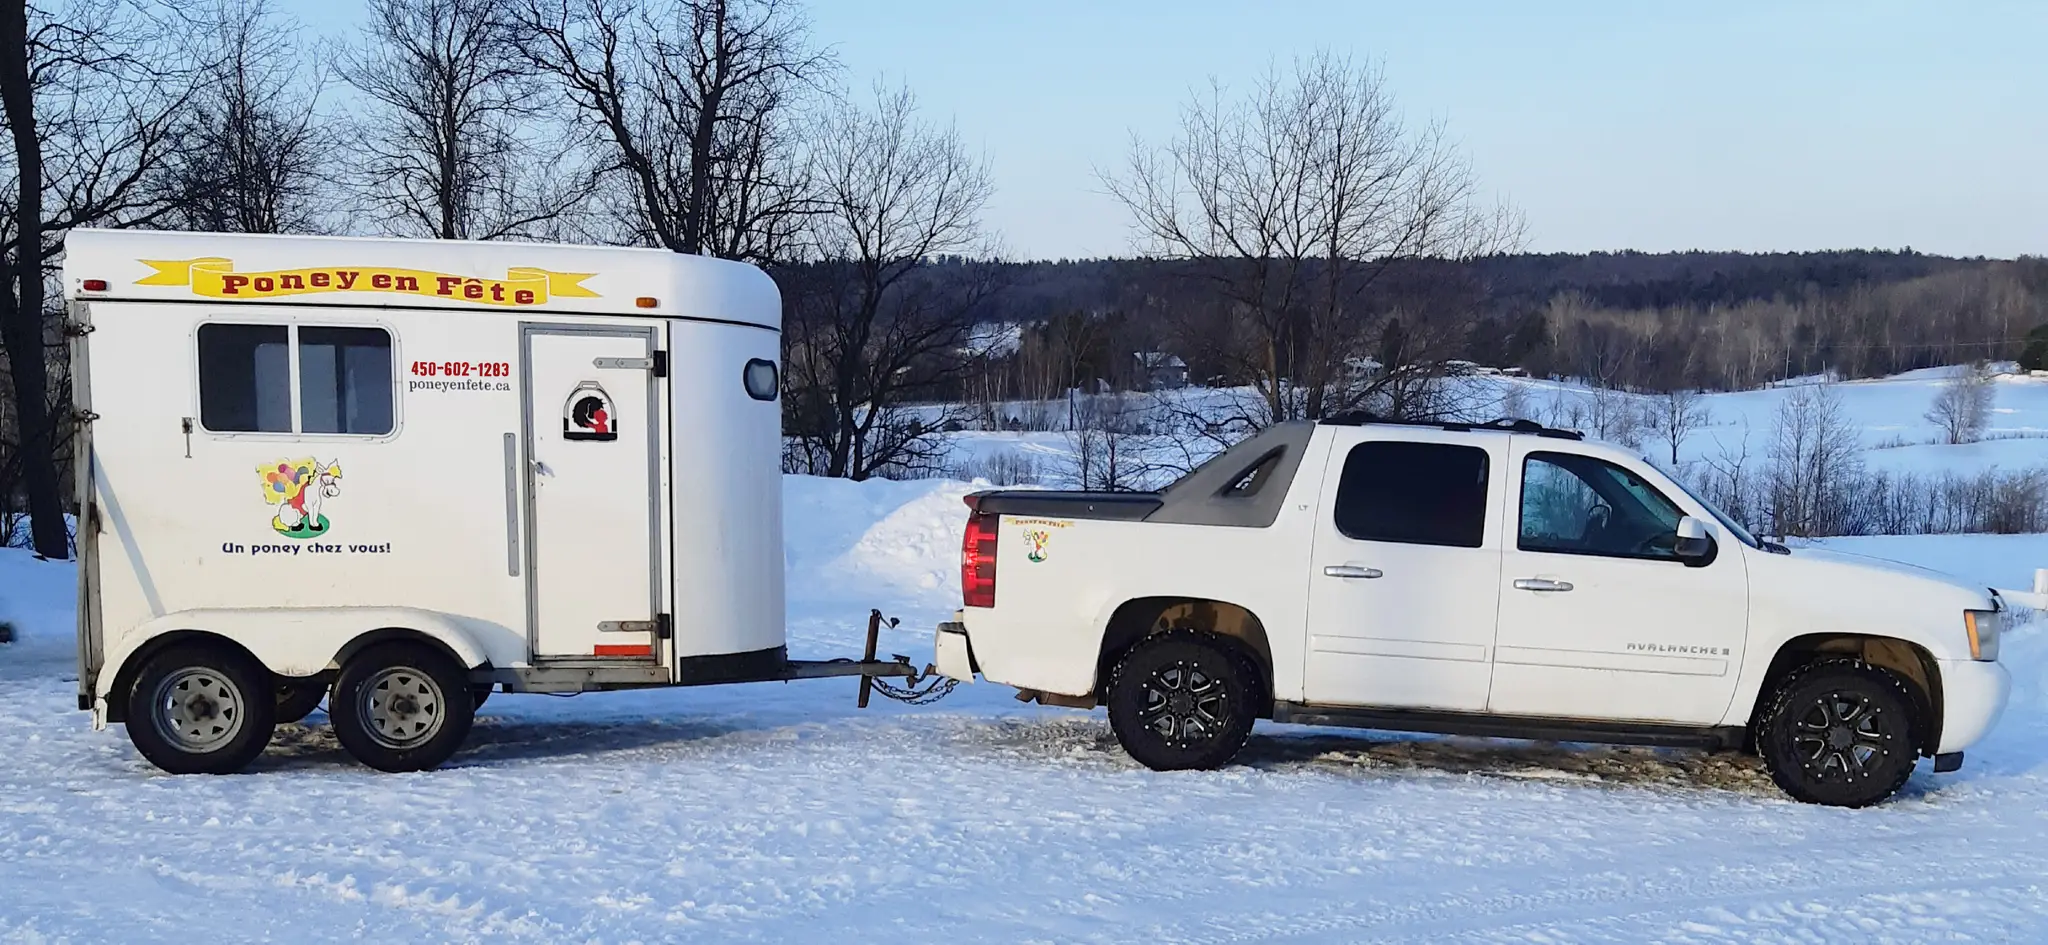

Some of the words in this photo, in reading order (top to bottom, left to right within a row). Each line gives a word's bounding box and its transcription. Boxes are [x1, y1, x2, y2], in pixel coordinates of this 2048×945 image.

[222, 271, 359, 294] Poney
[371, 273, 419, 291] en
[436, 277, 534, 304] Fête
[411, 361, 509, 377] 450-602-1283
[409, 379, 511, 392] poneyenfete.ca
[222, 542, 245, 554] Un
[251, 543, 301, 556] poney
[307, 542, 342, 554] chez
[349, 542, 391, 554] vous!
[1626, 642, 1718, 655] AVALANCHE
